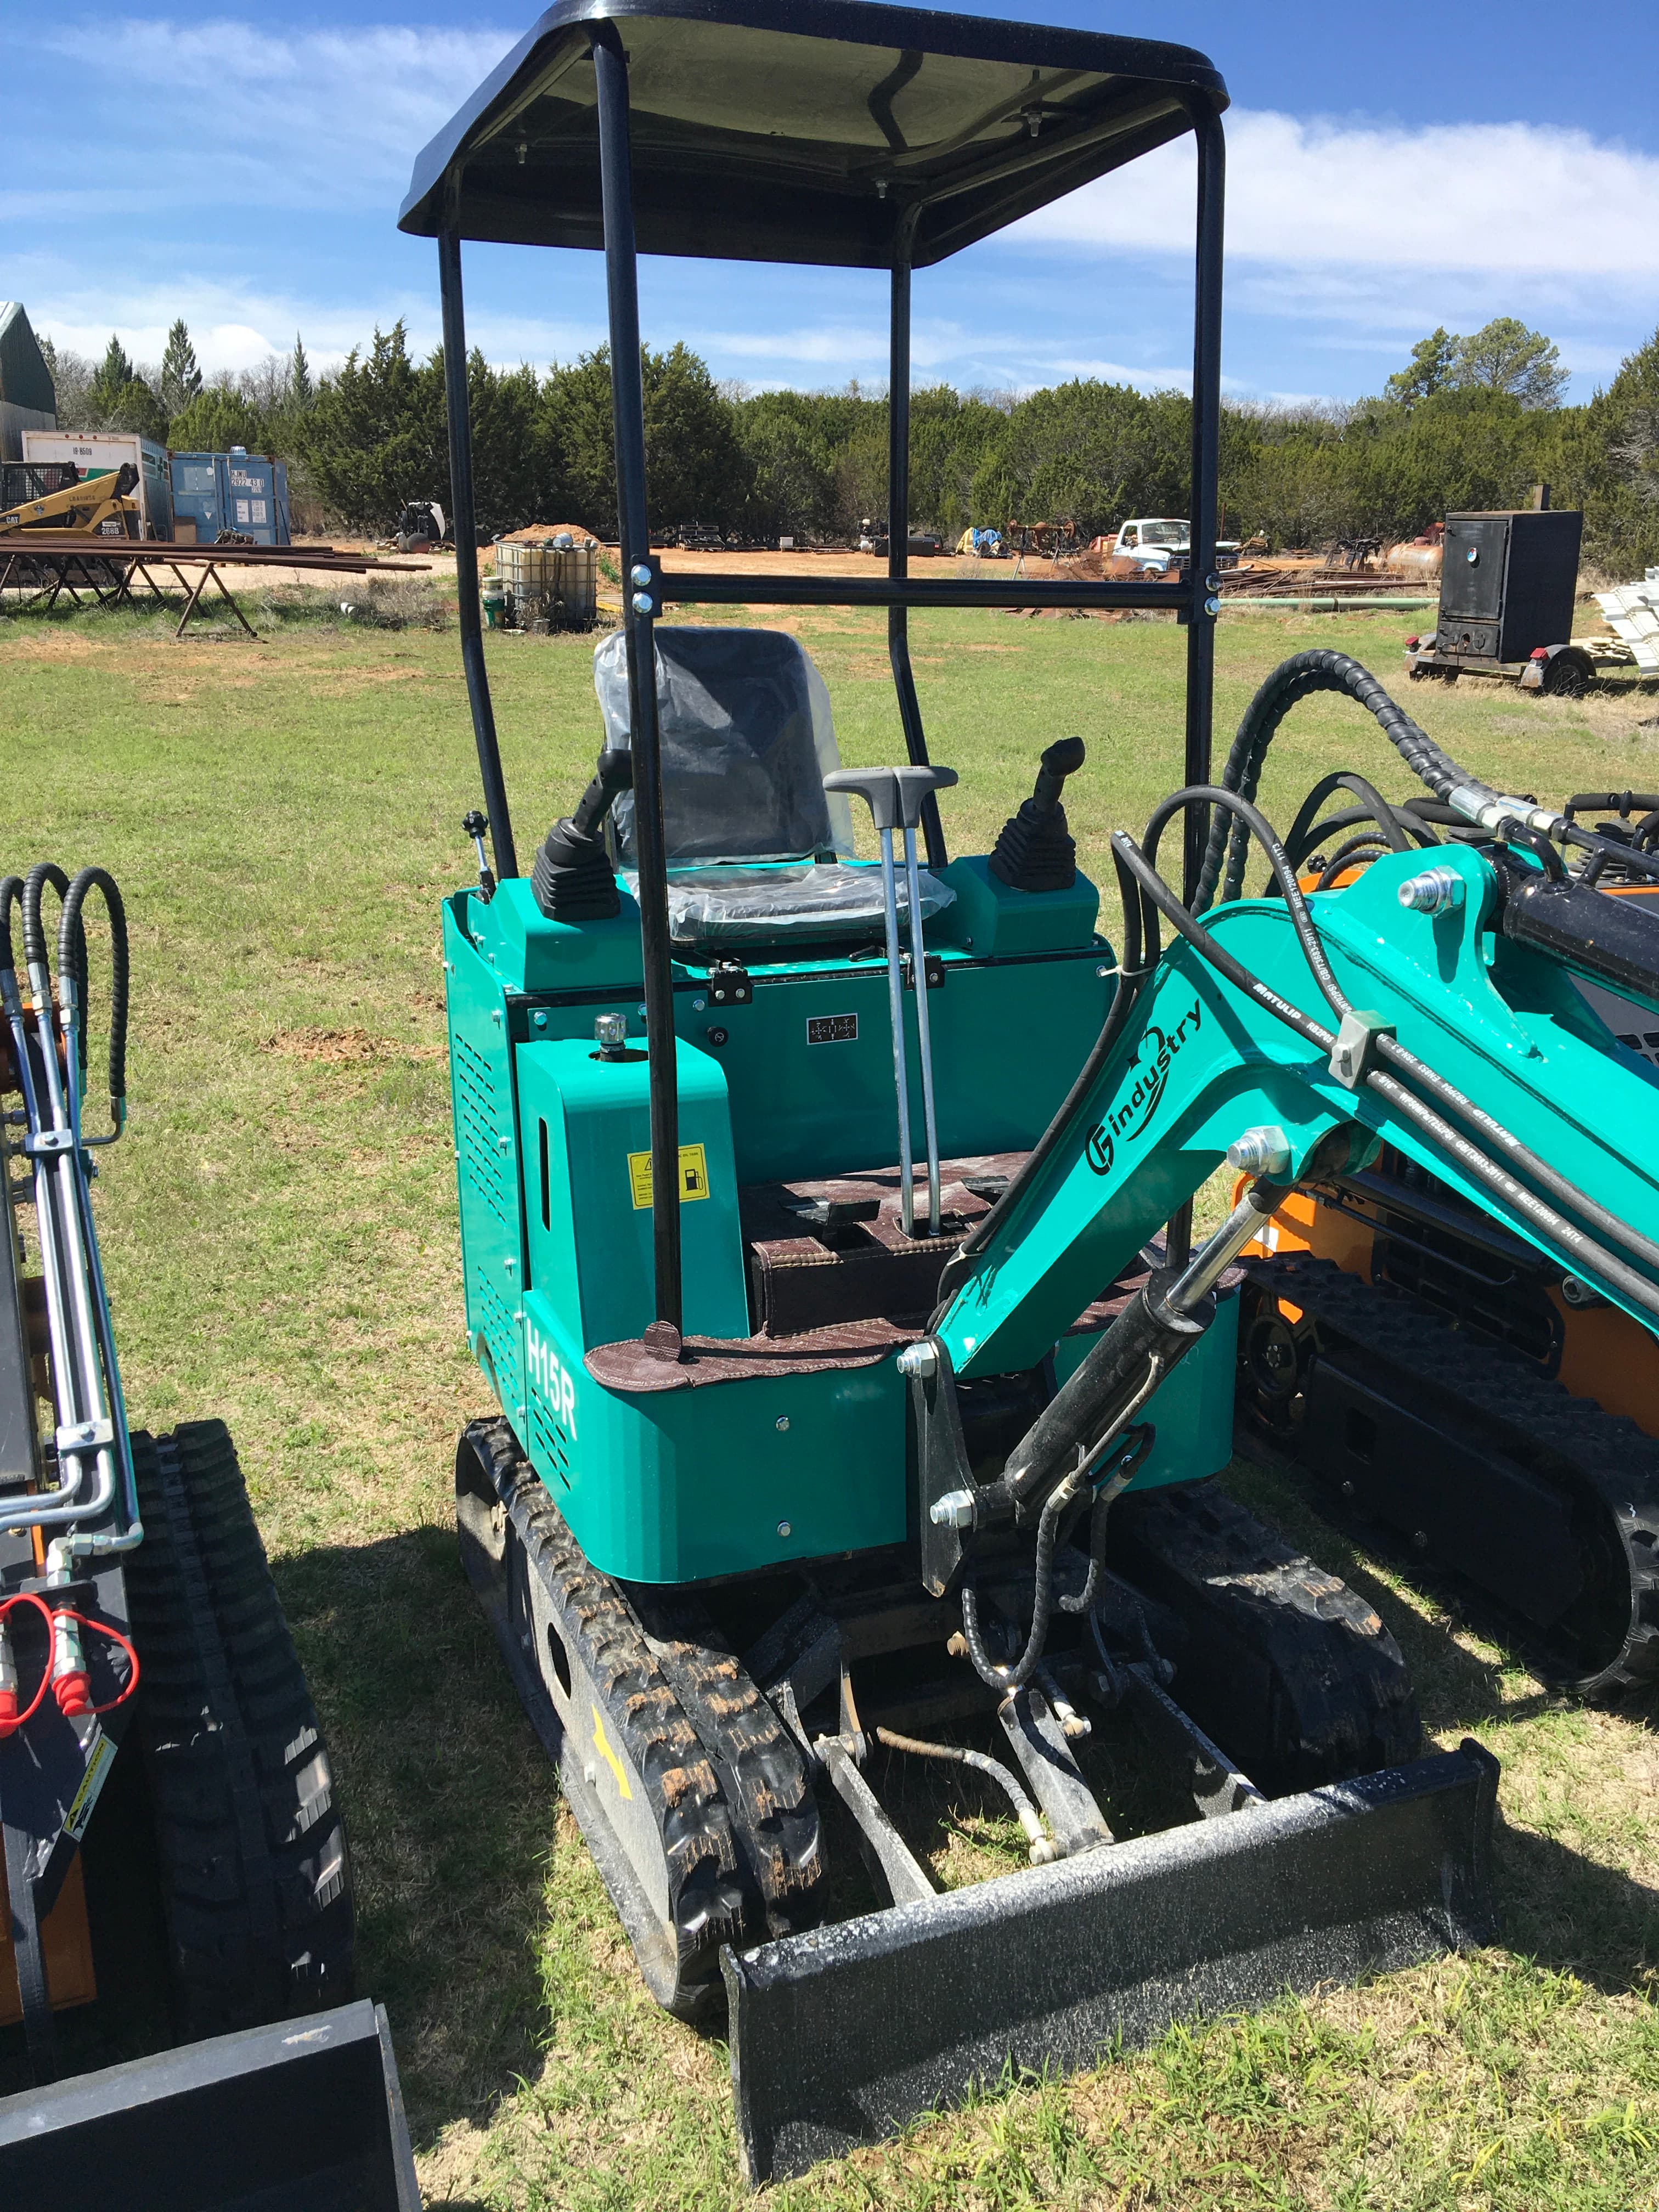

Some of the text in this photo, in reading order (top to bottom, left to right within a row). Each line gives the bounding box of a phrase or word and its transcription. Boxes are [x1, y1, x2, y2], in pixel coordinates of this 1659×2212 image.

[1282, 865, 1304, 909] MEE120094
[1304, 928, 1331, 981] GB/T3683-2011
[1253, 983, 1335, 1043] MATULIP RB2P05
[1418, 1064, 1440, 1083] EN853
[1441, 1083, 1470, 1105] RB2P04
[1472, 1109, 1522, 1148] MATULIP
[1517, 1192, 1559, 1226] MEE120094
[1561, 1227, 1584, 1244] 24T4
[526, 1317, 577, 1441] H15R
[77, 1743, 105, 1803] CAUTION
